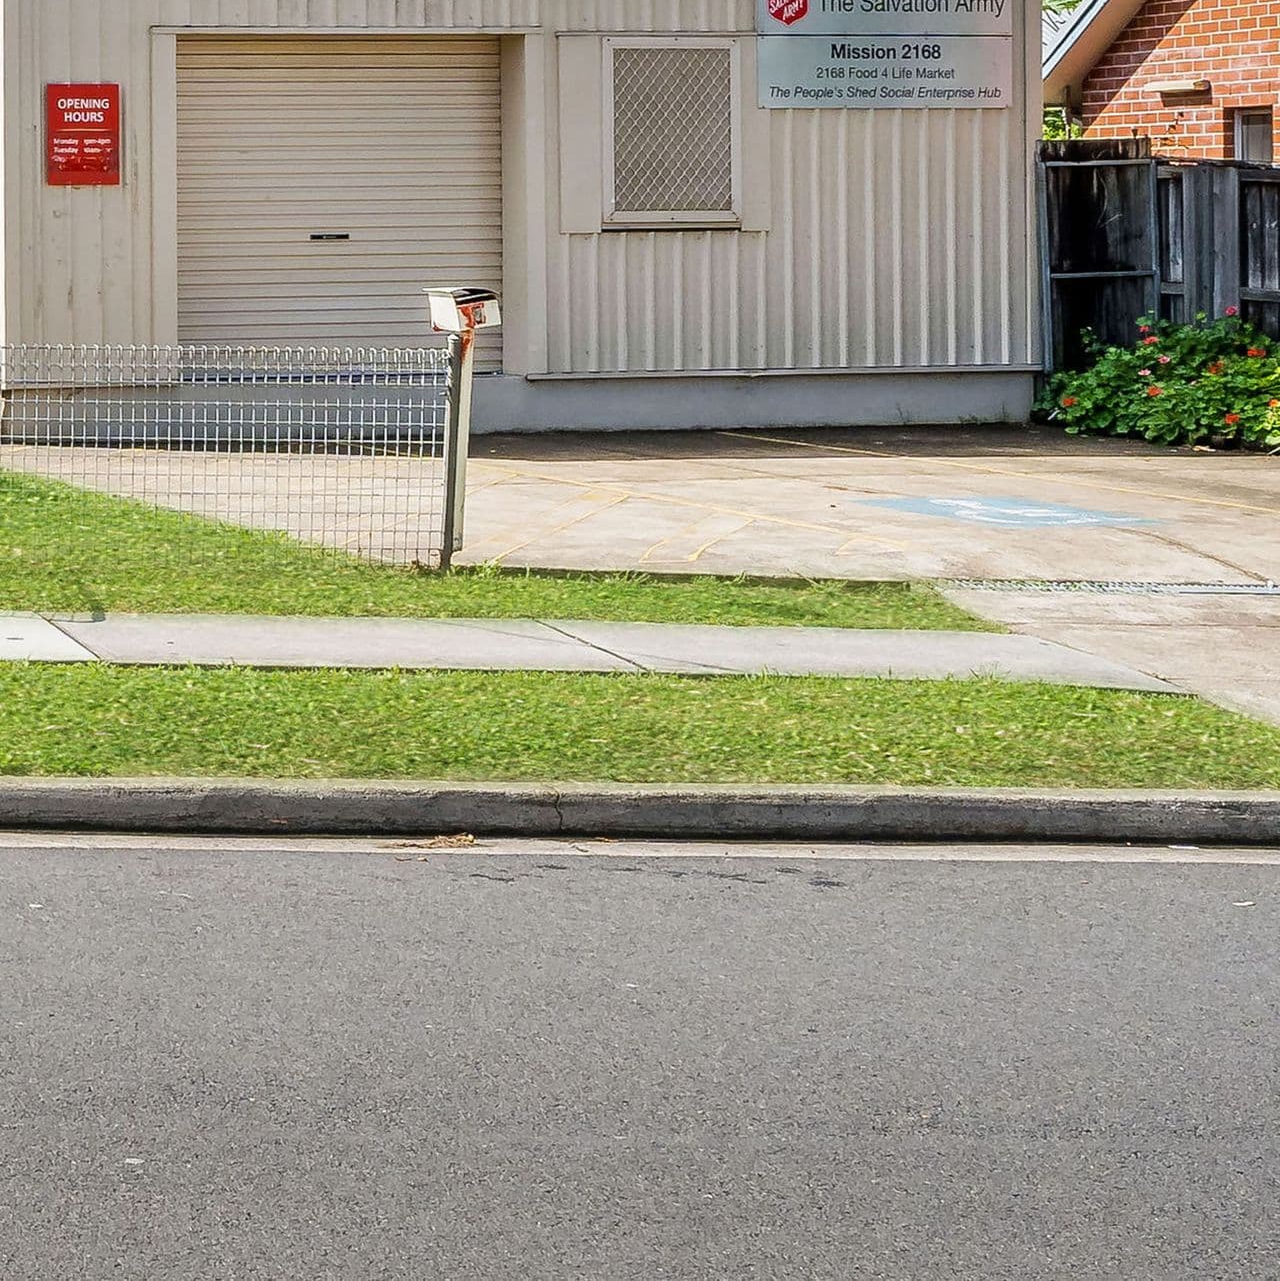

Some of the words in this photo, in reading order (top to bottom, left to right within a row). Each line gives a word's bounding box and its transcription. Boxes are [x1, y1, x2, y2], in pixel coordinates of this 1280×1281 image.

[831, 44, 897, 59] Mission
[901, 44, 941, 59] 2168
[816, 67, 845, 79] 2168
[848, 67, 878, 79] Food
[881, 67, 888, 79] 4
[892, 67, 913, 79] Life
[916, 67, 955, 79] Market
[769, 86, 791, 98] The
[794, 86, 844, 100] People's
[846, 86, 877, 98] Shed
[879, 86, 915, 98] Social
[917, 86, 975, 100] Enterprise
[977, 86, 1002, 98] Hub
[57, 99, 110, 109] OPENING
[64, 112, 104, 122] HOURS
